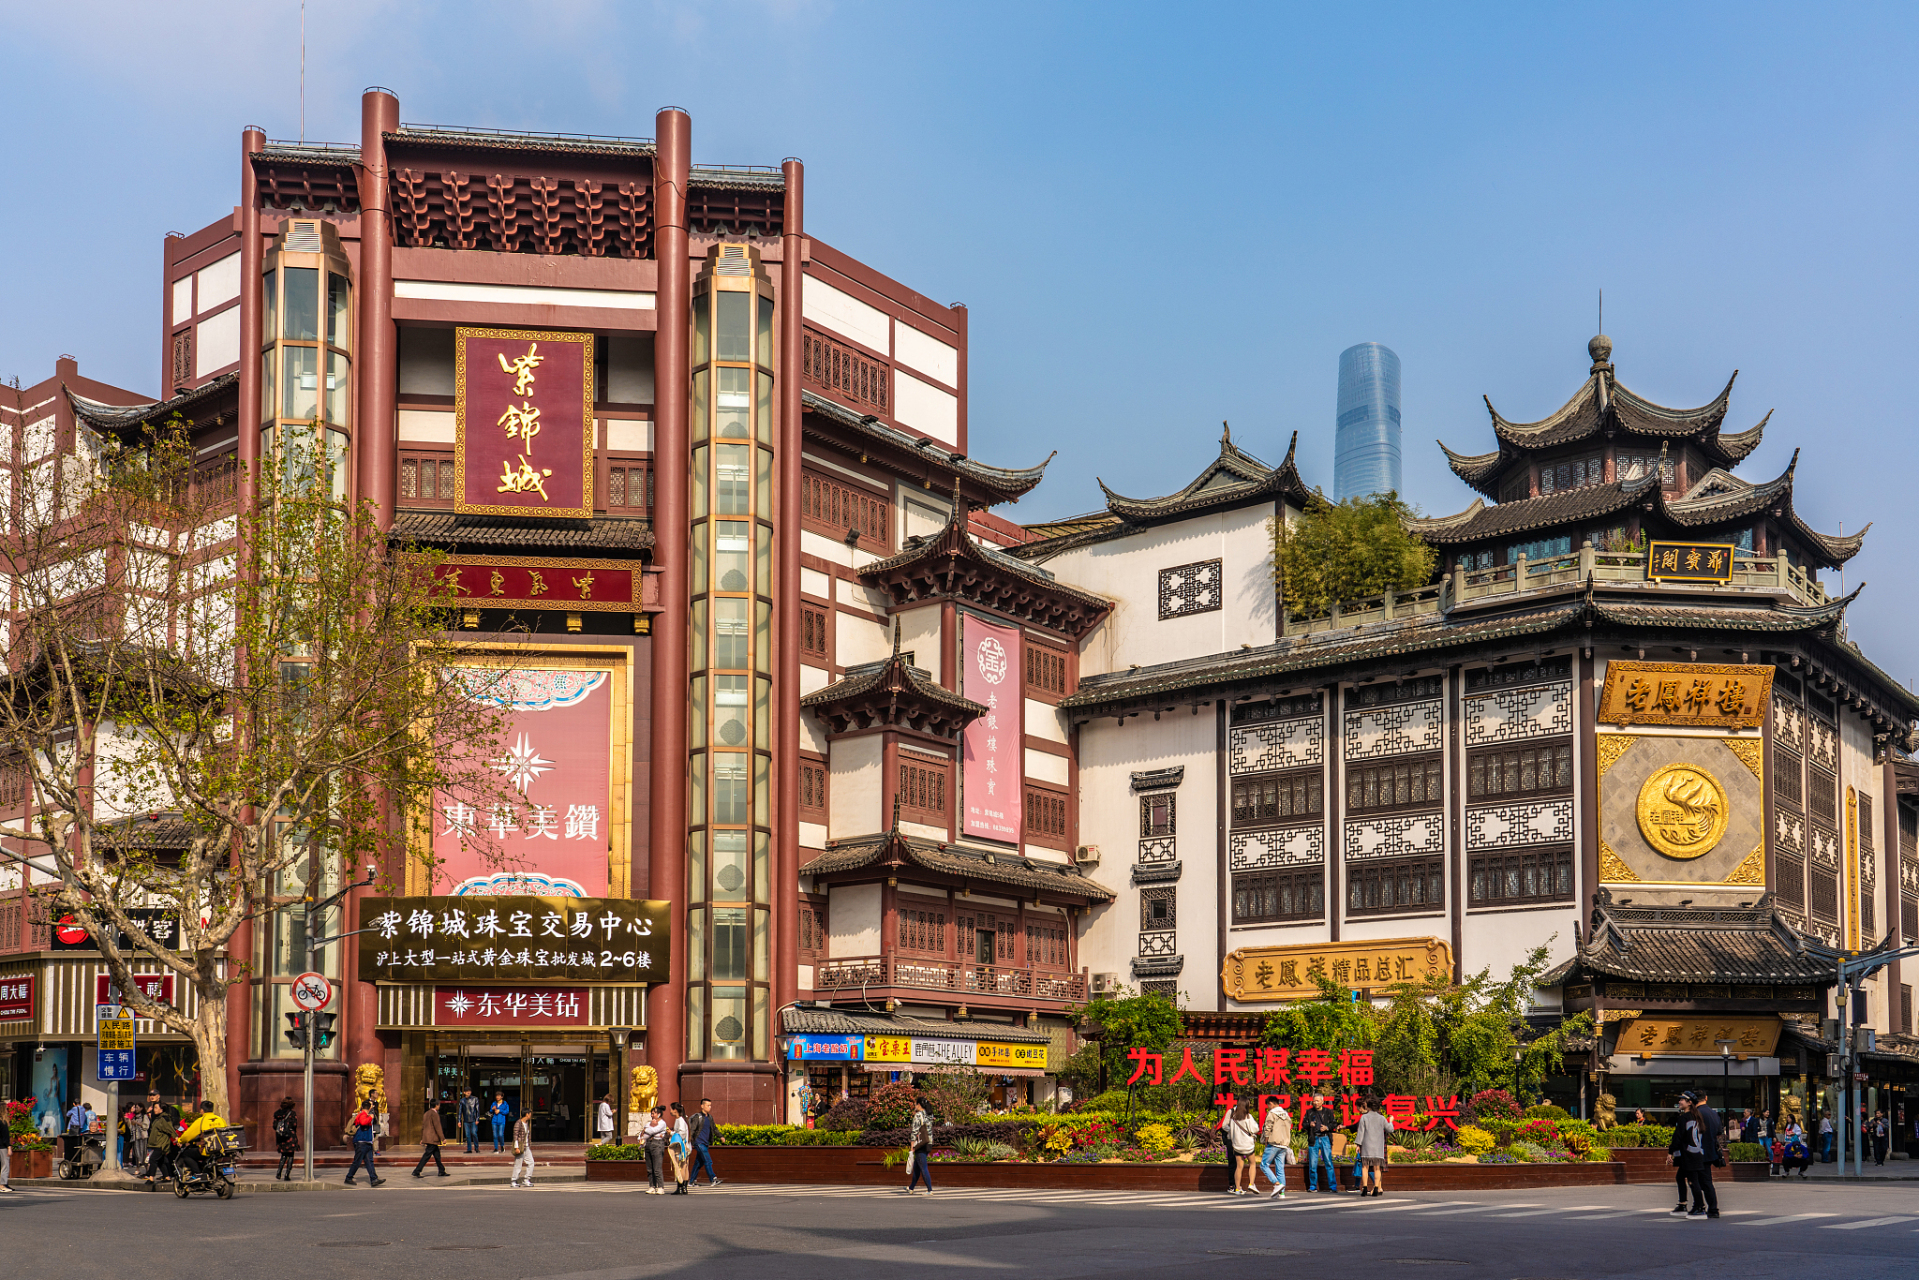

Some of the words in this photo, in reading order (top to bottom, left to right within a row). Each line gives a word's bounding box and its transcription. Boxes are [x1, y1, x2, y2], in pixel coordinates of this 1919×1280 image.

[440, 801, 600, 842] 東華美鑽
[378, 908, 653, 940] 紫锦城珠宝交易中心
[476, 992, 581, 1018] 东华美钻
[101, 1021, 131, 1030] 人民路
[100, 1040, 133, 1049] 道路施工
[803, 1042, 849, 1054] 上海老酸奶
[937, 1043, 951, 1058] THE
[951, 1043, 974, 1059] ALLEY
[104, 1065, 129, 1077] 慢行
[1126, 1046, 1376, 1087] 为人民谋幸福
